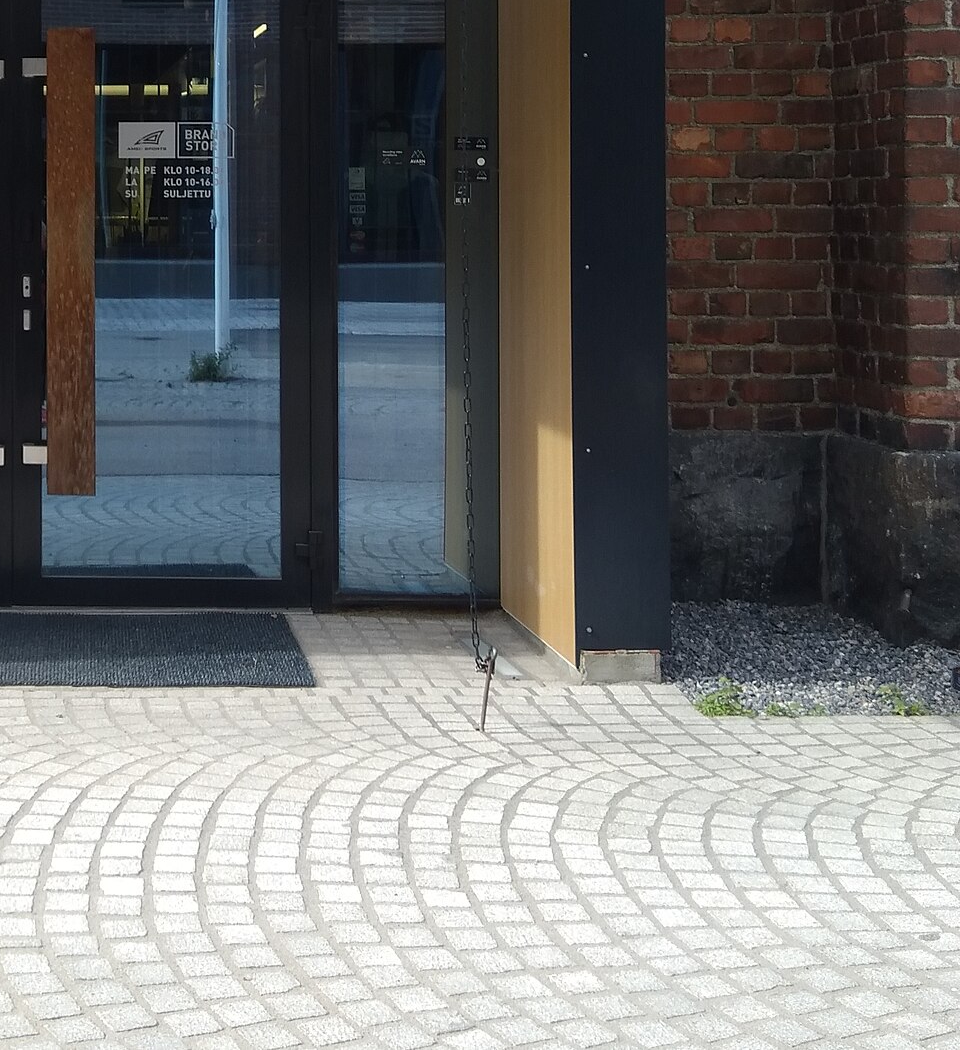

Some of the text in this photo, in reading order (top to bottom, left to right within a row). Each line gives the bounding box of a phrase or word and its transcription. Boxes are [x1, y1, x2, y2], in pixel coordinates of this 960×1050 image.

[185, 130, 223, 140] BRAN
[185, 140, 221, 151] STOR
[163, 166, 183, 175] KLO
[125, 178, 138, 187] LA
[163, 178, 183, 187] KLO
[125, 190, 211, 198] SU SULJETTU
